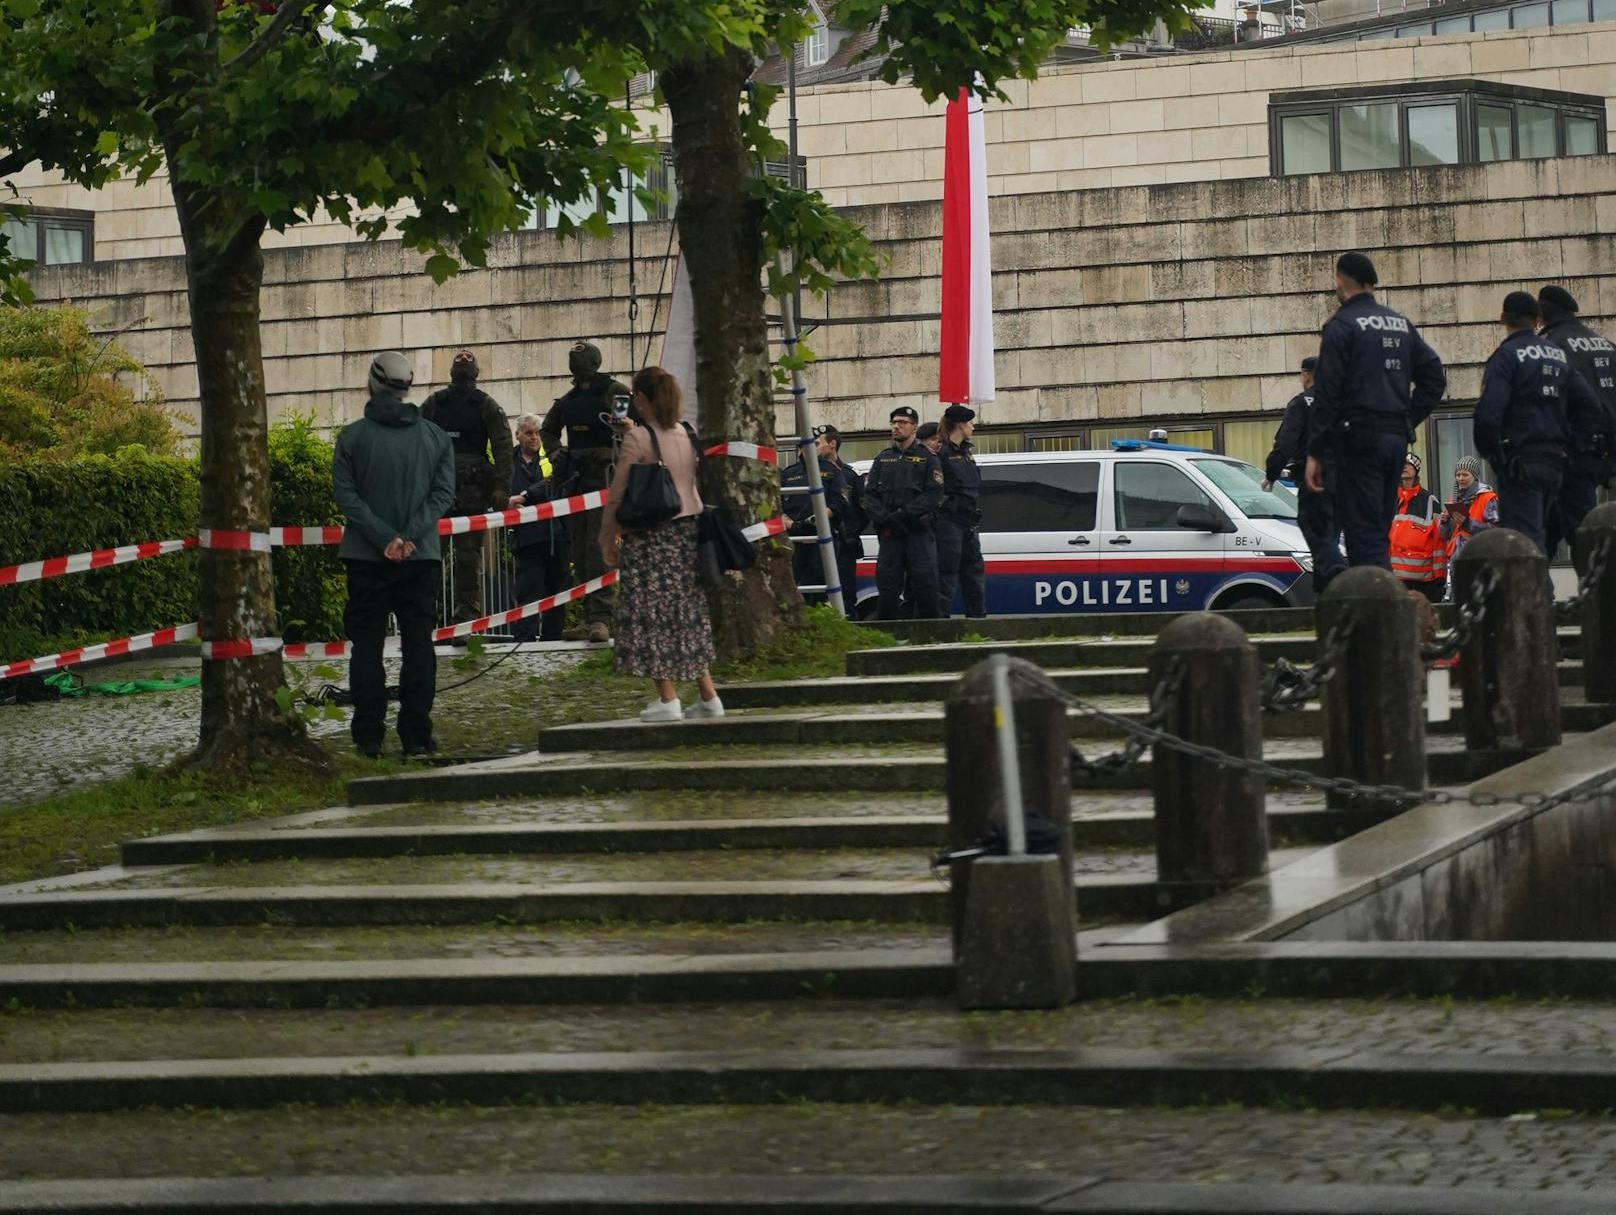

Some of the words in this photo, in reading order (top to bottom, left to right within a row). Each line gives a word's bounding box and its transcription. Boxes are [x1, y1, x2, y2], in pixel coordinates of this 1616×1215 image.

[1356, 315, 1409, 333] POLIZEI
[1516, 345, 1568, 363] POLIZEI
[1385, 359, 1401, 370] 812
[1235, 537, 1248, 546] BE
[1255, 537, 1262, 546] V
[1035, 579, 1168, 606] POLIZEI
